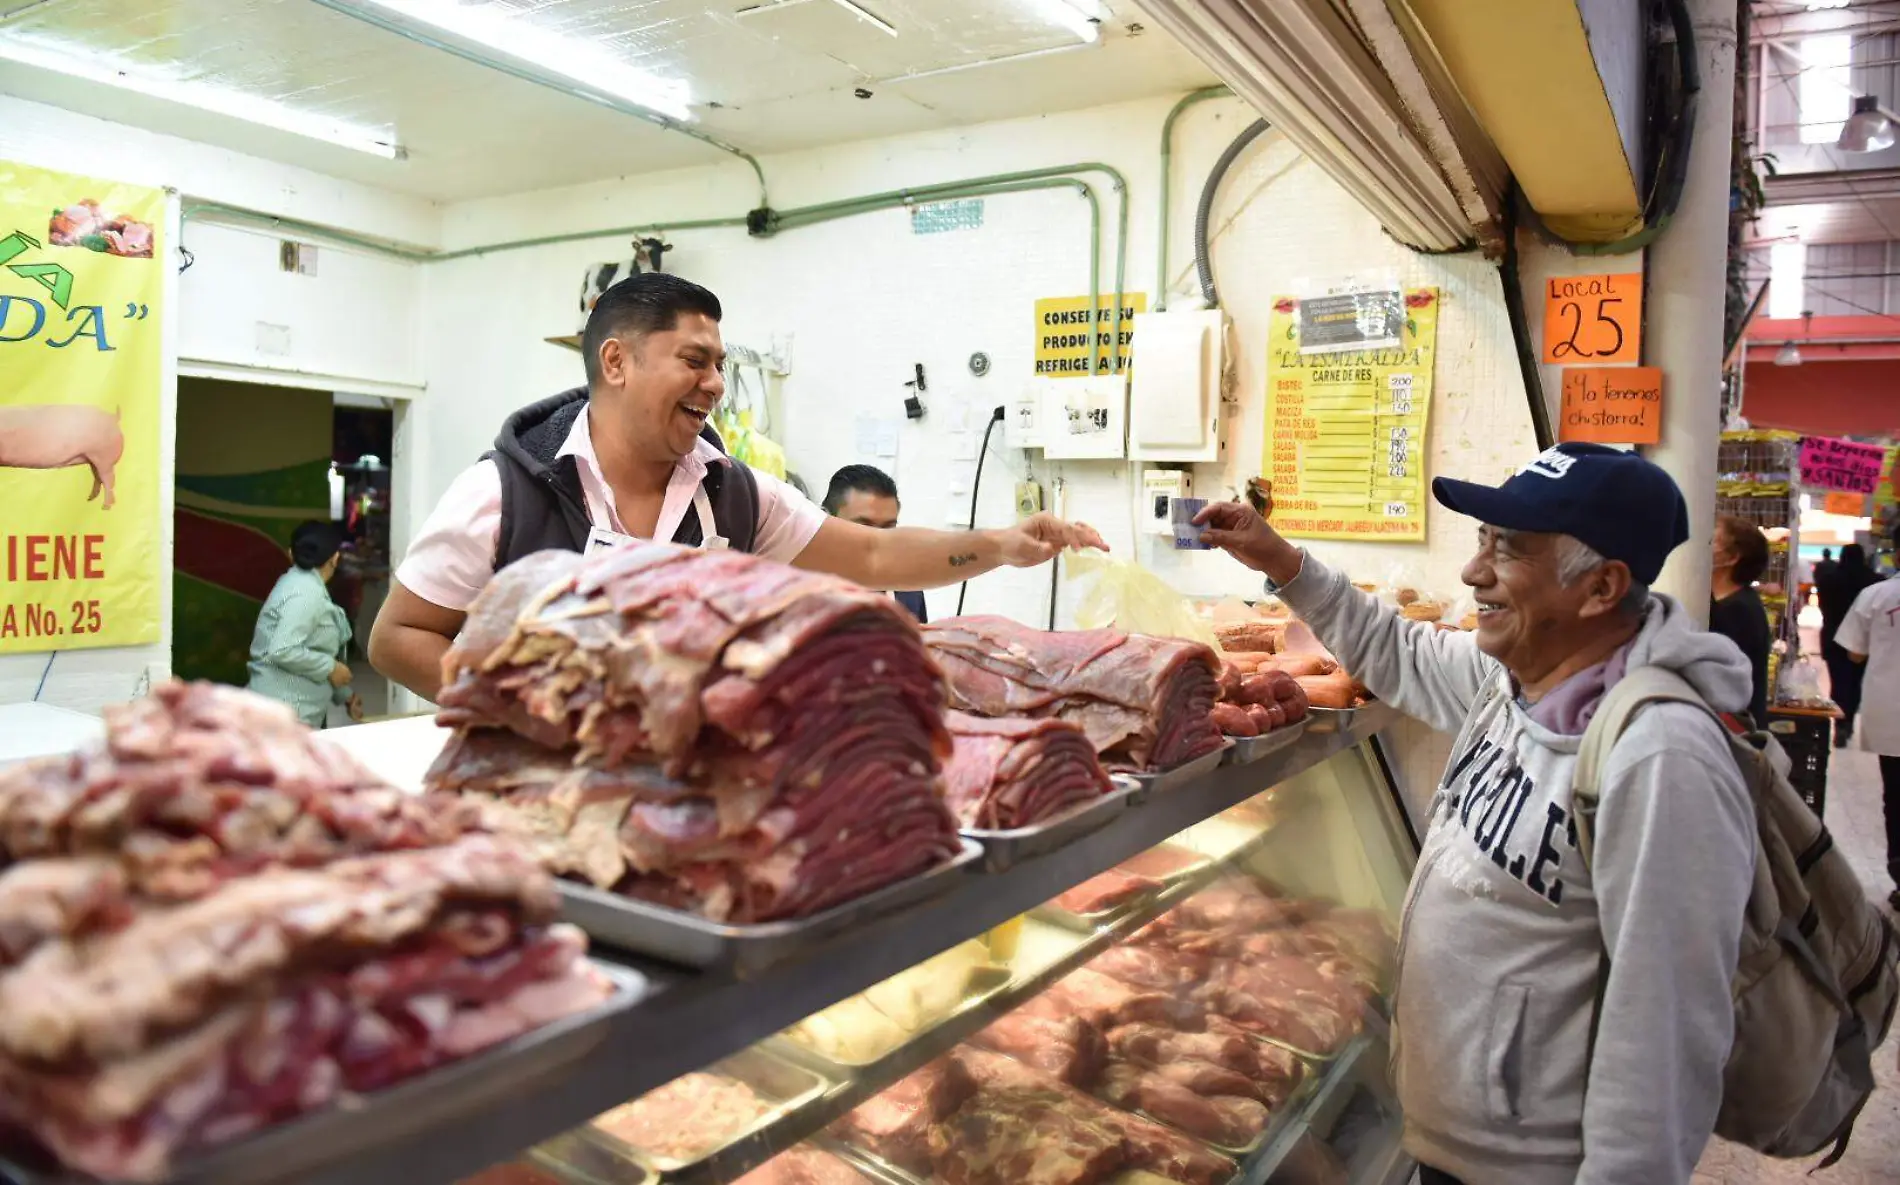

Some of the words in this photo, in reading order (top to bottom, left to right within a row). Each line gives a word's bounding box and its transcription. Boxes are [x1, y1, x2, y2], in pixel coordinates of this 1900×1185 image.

[1550, 275, 1616, 299] Local
[1552, 299, 1624, 357] 25
[1043, 333, 1111, 349] PRODUTO
[1313, 369, 1342, 382] CARNE
[1343, 368, 1353, 381] DE
[1354, 368, 1372, 380] RES
[1275, 393, 1304, 405] COSTILLA
[1602, 379, 1660, 402] tenemos
[1567, 405, 1645, 427] chistorra!
[8, 535, 105, 582] IENE
[26, 603, 64, 637] No.
[71, 600, 102, 634] 25
